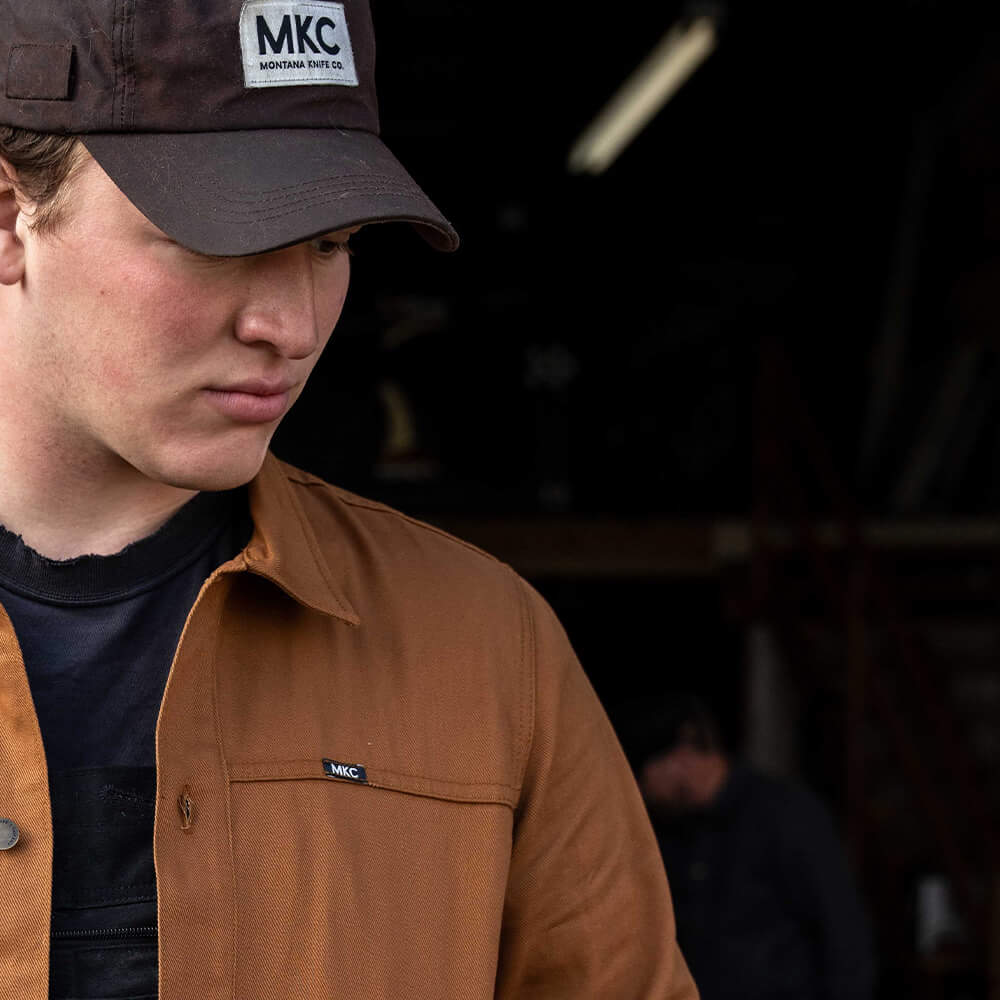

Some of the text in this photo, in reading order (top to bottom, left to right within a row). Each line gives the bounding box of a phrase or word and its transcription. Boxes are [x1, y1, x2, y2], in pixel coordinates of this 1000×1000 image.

[256, 14, 341, 55] MKC
[260, 60, 344, 71] MONTANA KNIFE CO.
[331, 763, 359, 778] MKC
